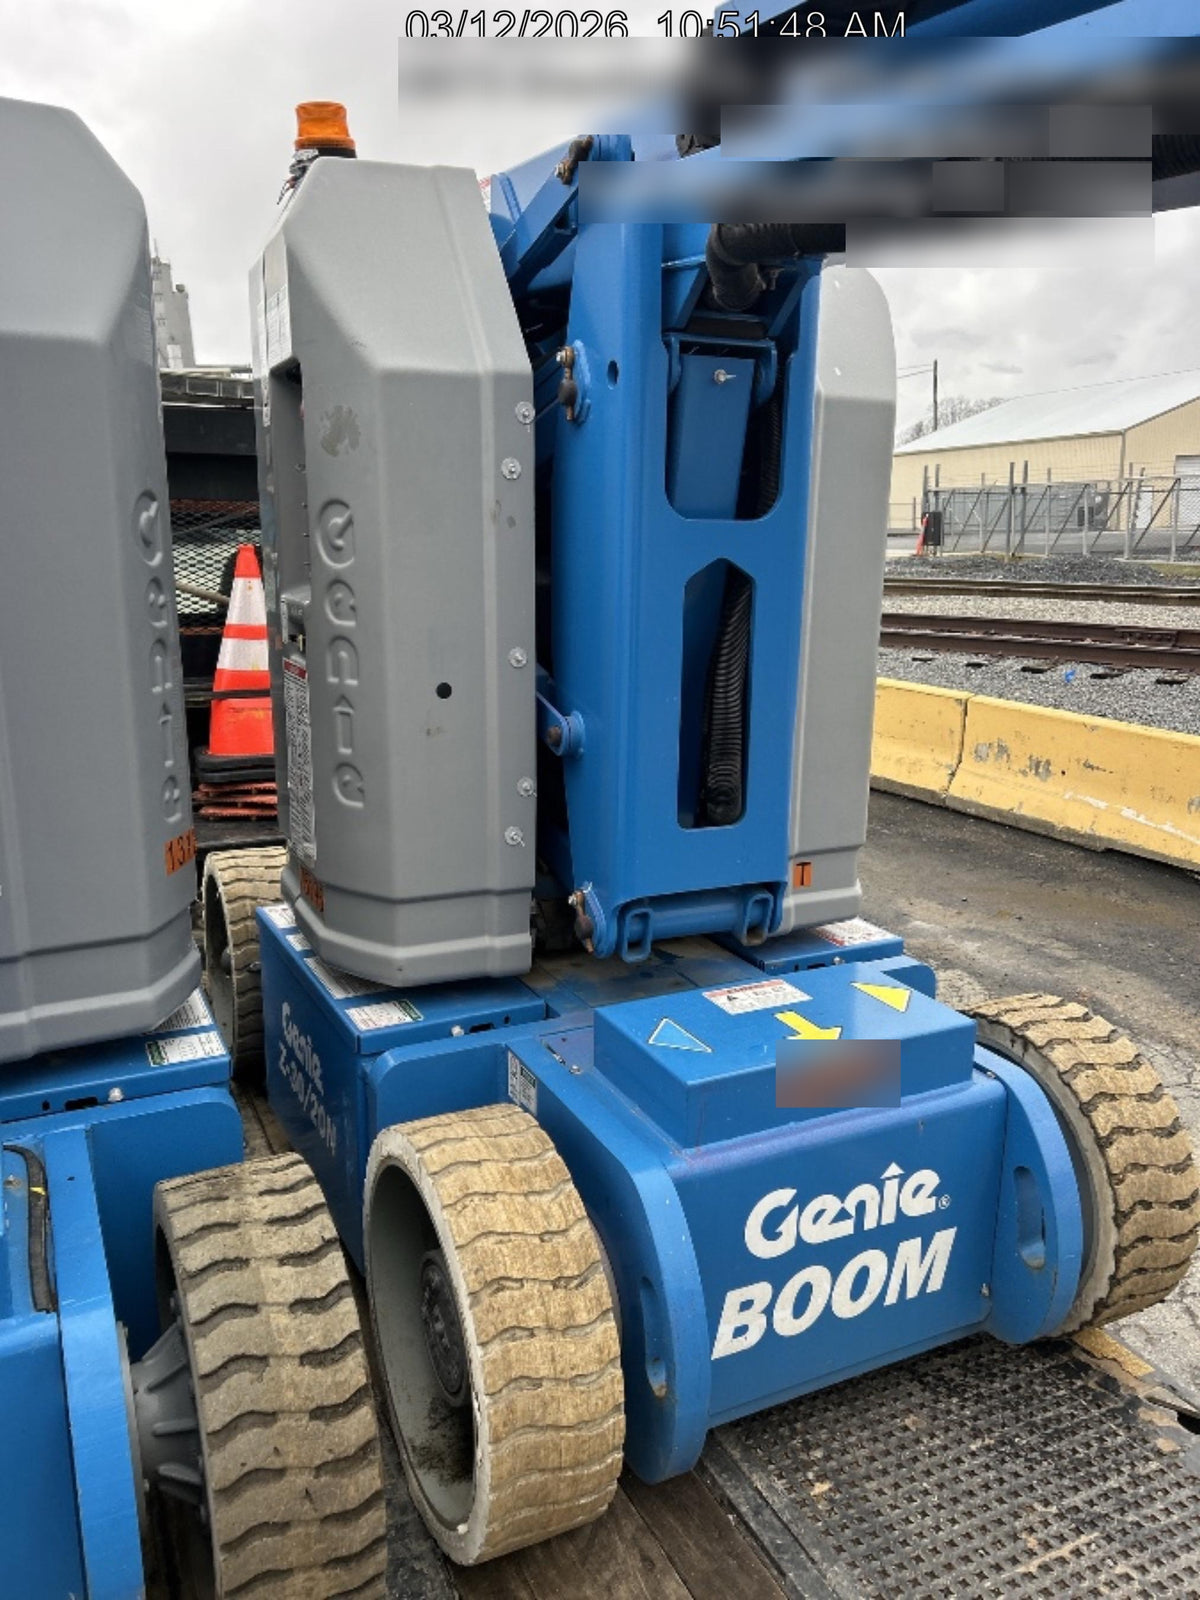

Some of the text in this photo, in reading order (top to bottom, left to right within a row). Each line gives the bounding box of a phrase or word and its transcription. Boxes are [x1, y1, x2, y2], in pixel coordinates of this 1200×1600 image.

[316, 498, 365, 809] Genie
[281, 1001, 325, 1097] Genie
[744, 1161, 941, 1260] Genie
[711, 1226, 958, 1361] BOOM
